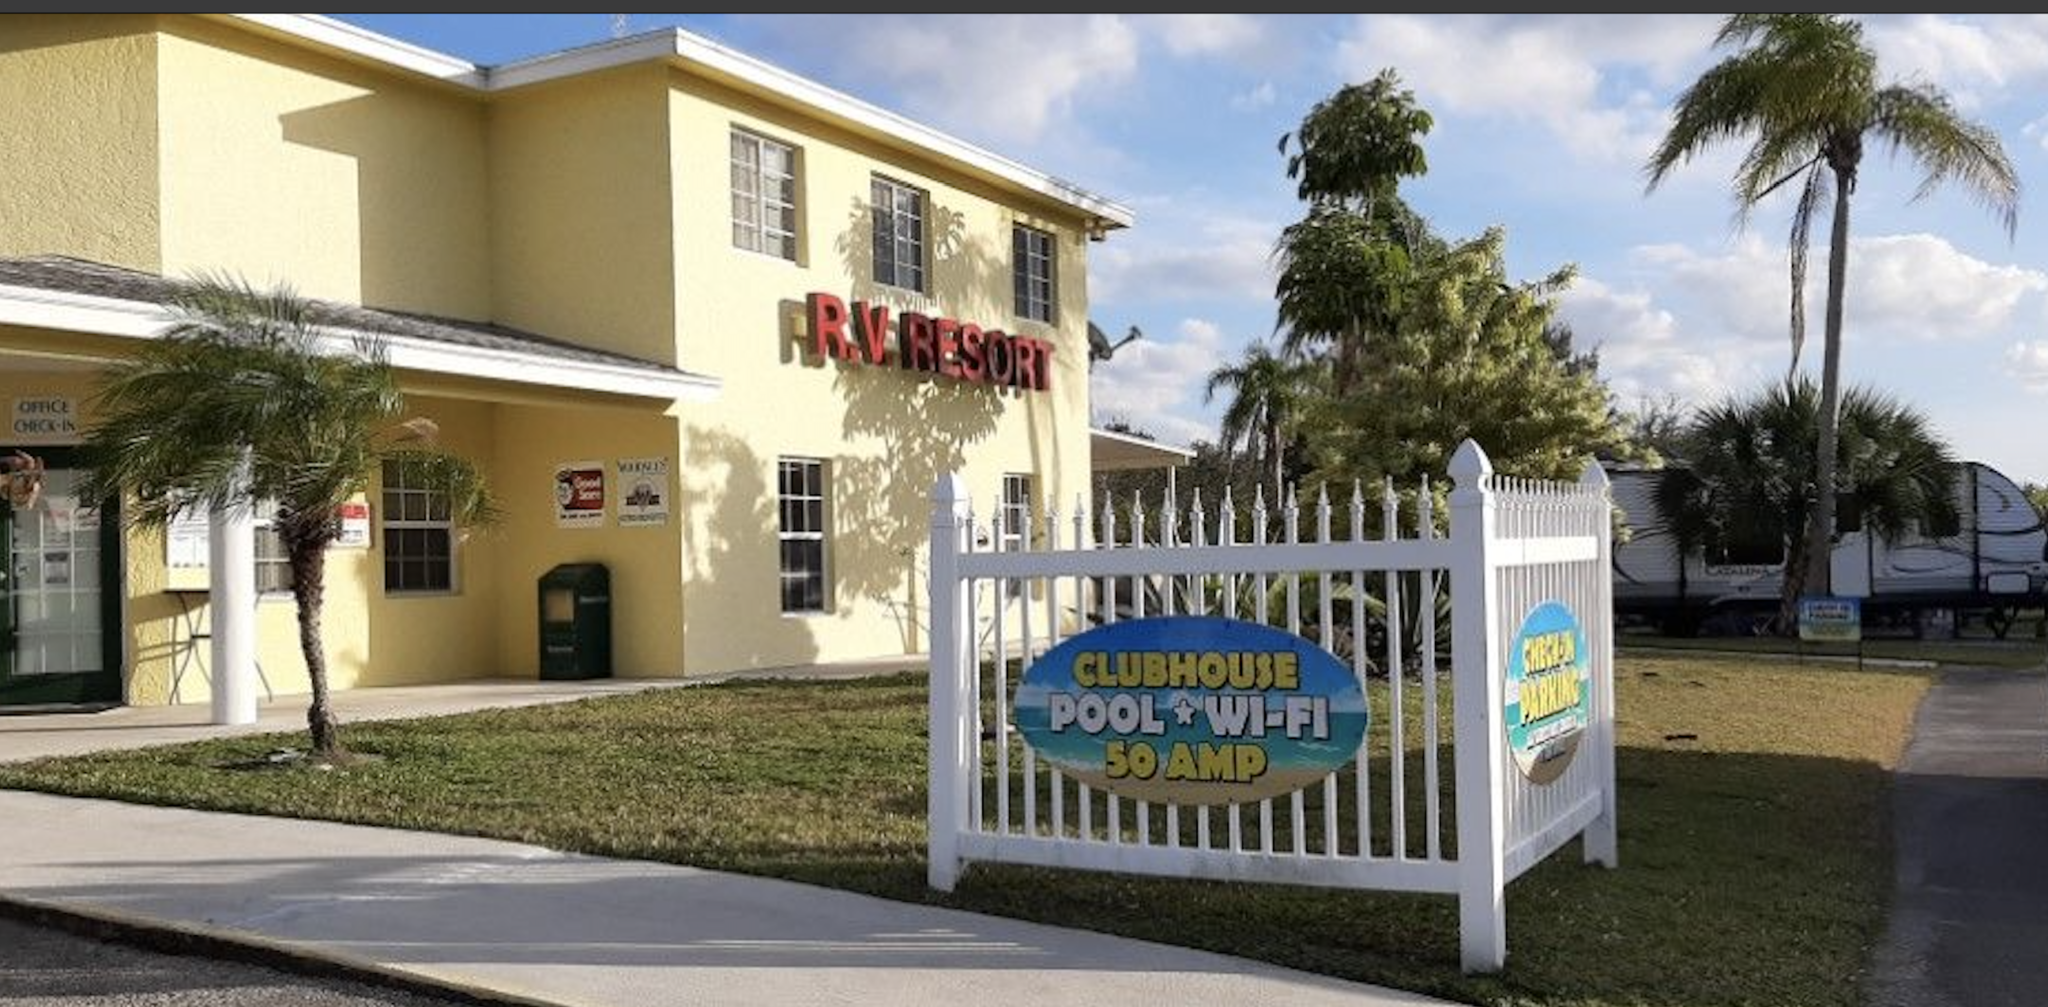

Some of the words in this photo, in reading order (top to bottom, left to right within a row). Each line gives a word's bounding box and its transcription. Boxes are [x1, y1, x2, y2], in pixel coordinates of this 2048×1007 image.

[900, 311, 1055, 392] RESORT
[14, 419, 76, 433] CHECK-IN
[19, 401, 69, 413] OFFICE
[573, 475, 601, 489] Good
[1073, 651, 1299, 690] CLUBHOUSE
[1050, 693, 1165, 736] POOL
[1204, 695, 1330, 740] WI-FI
[1519, 667, 1581, 728] PARKING
[1105, 740, 1159, 780] 50
[1164, 740, 1268, 783] AMP
